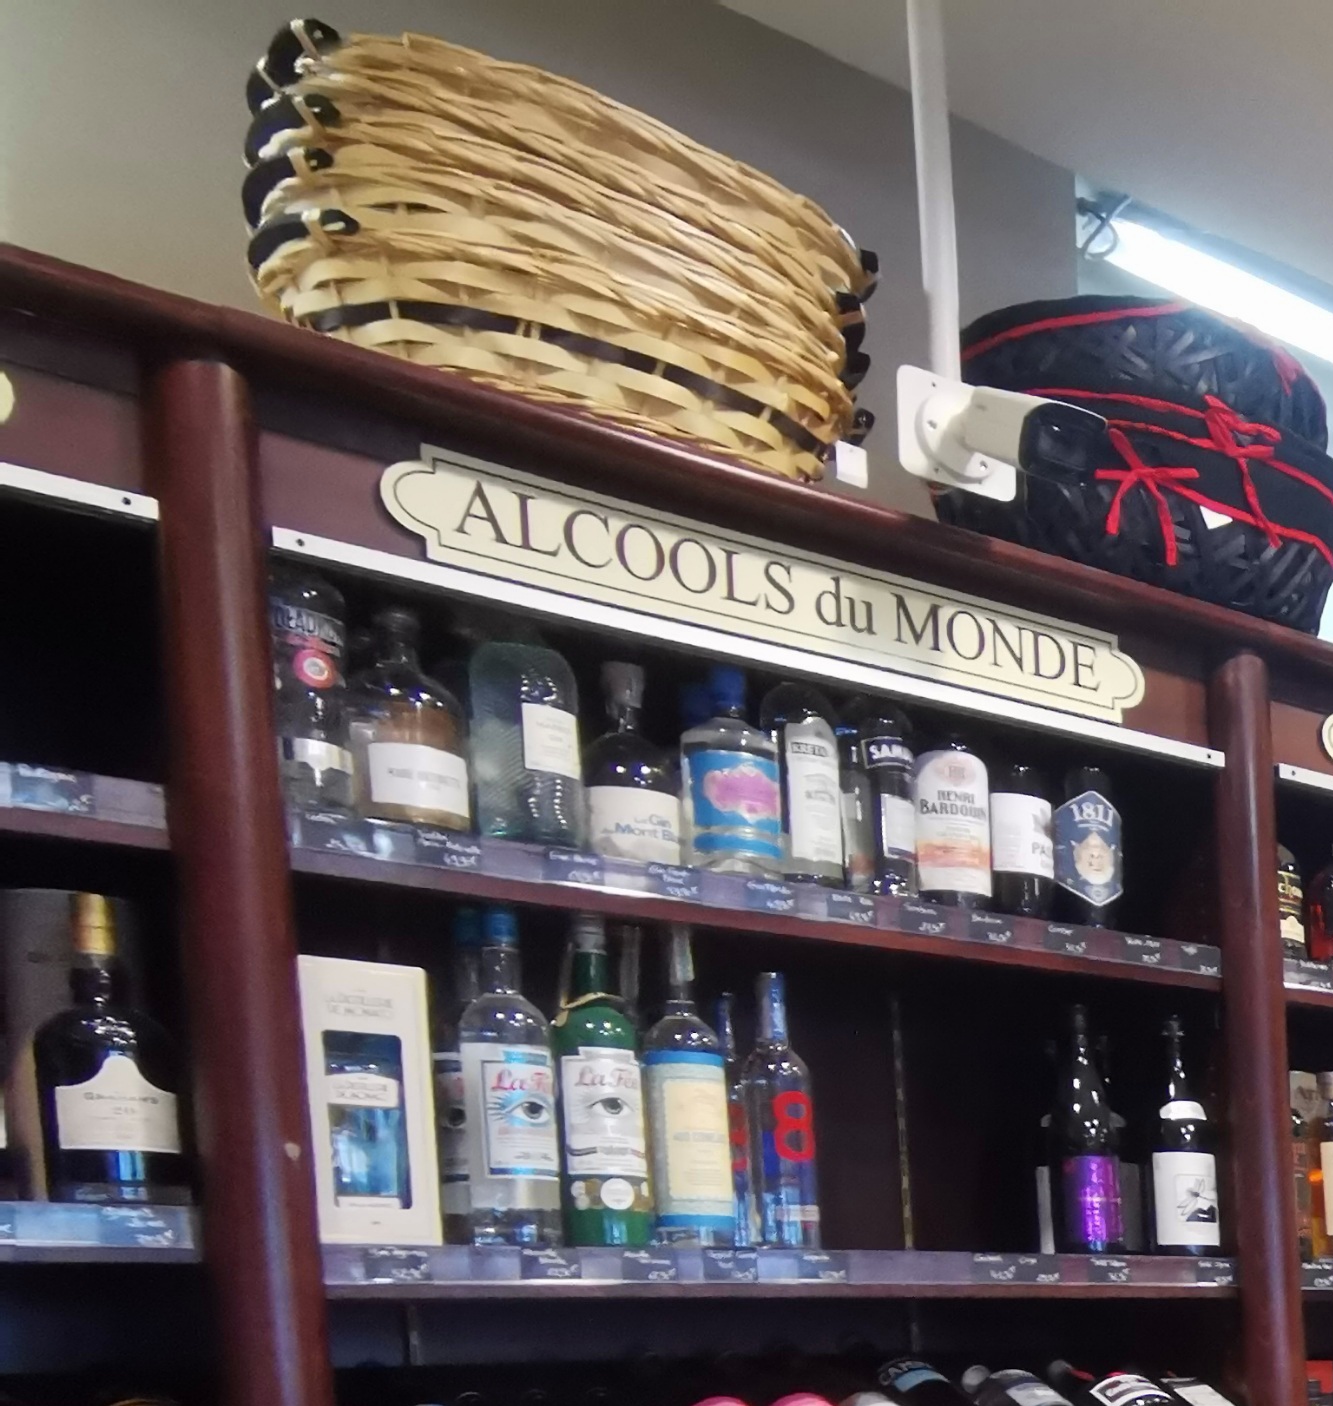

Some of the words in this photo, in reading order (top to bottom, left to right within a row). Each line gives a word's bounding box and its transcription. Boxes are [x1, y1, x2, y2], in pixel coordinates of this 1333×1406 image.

[454, 479, 796, 617] ALCOOLS
[814, 575, 875, 637] du
[892, 593, 1102, 692] MONDE
[770, 1090, 816, 1162] 8
